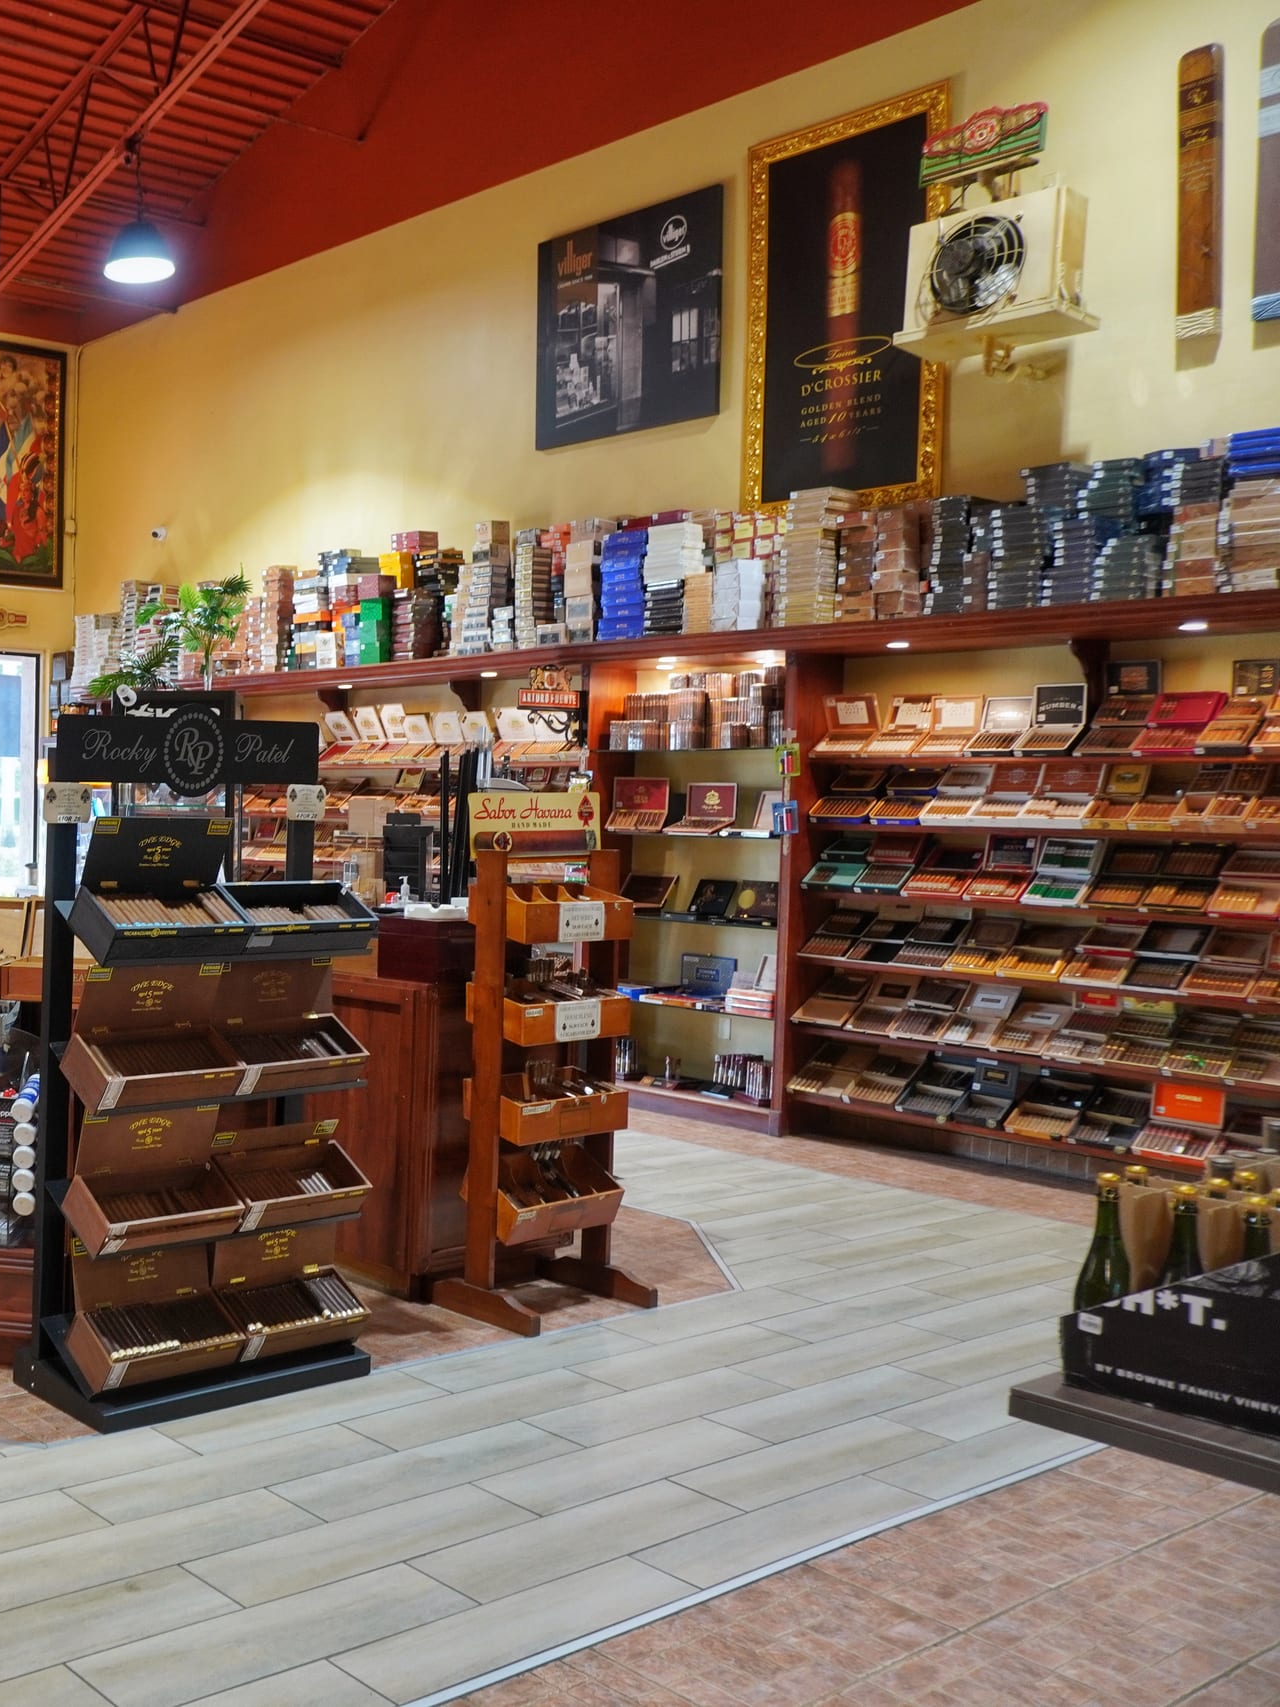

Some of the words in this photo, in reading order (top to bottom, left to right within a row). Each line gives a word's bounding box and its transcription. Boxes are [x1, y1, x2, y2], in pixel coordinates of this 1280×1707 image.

[558, 240, 592, 277] villiger
[801, 401, 841, 415] GOLDEN
[847, 394, 881, 406] BLEND
[800, 416, 826, 428] AGED
[828, 410, 847, 424] 10
[849, 407, 881, 419] YEARS
[521, 692, 549, 703] ARTURO
[550, 693, 577, 705] FUENTE
[81, 727, 157, 774] Rocky
[174, 727, 214, 775] RP
[234, 729, 296, 765] Patel
[474, 797, 516, 820] Sabor
[520, 795, 572, 820] Havana
[139, 836, 158, 847] THE
[159, 835, 182, 848] EDGE
[131, 980, 148, 992] THE
[150, 980, 175, 992] EDGE
[1095, 1363, 1113, 1375] BY
[1116, 1368, 1174, 1389] BROWNE
[1179, 1382, 1232, 1403] FAMILY
[1235, 1396, 1280, 1416] VINEY
